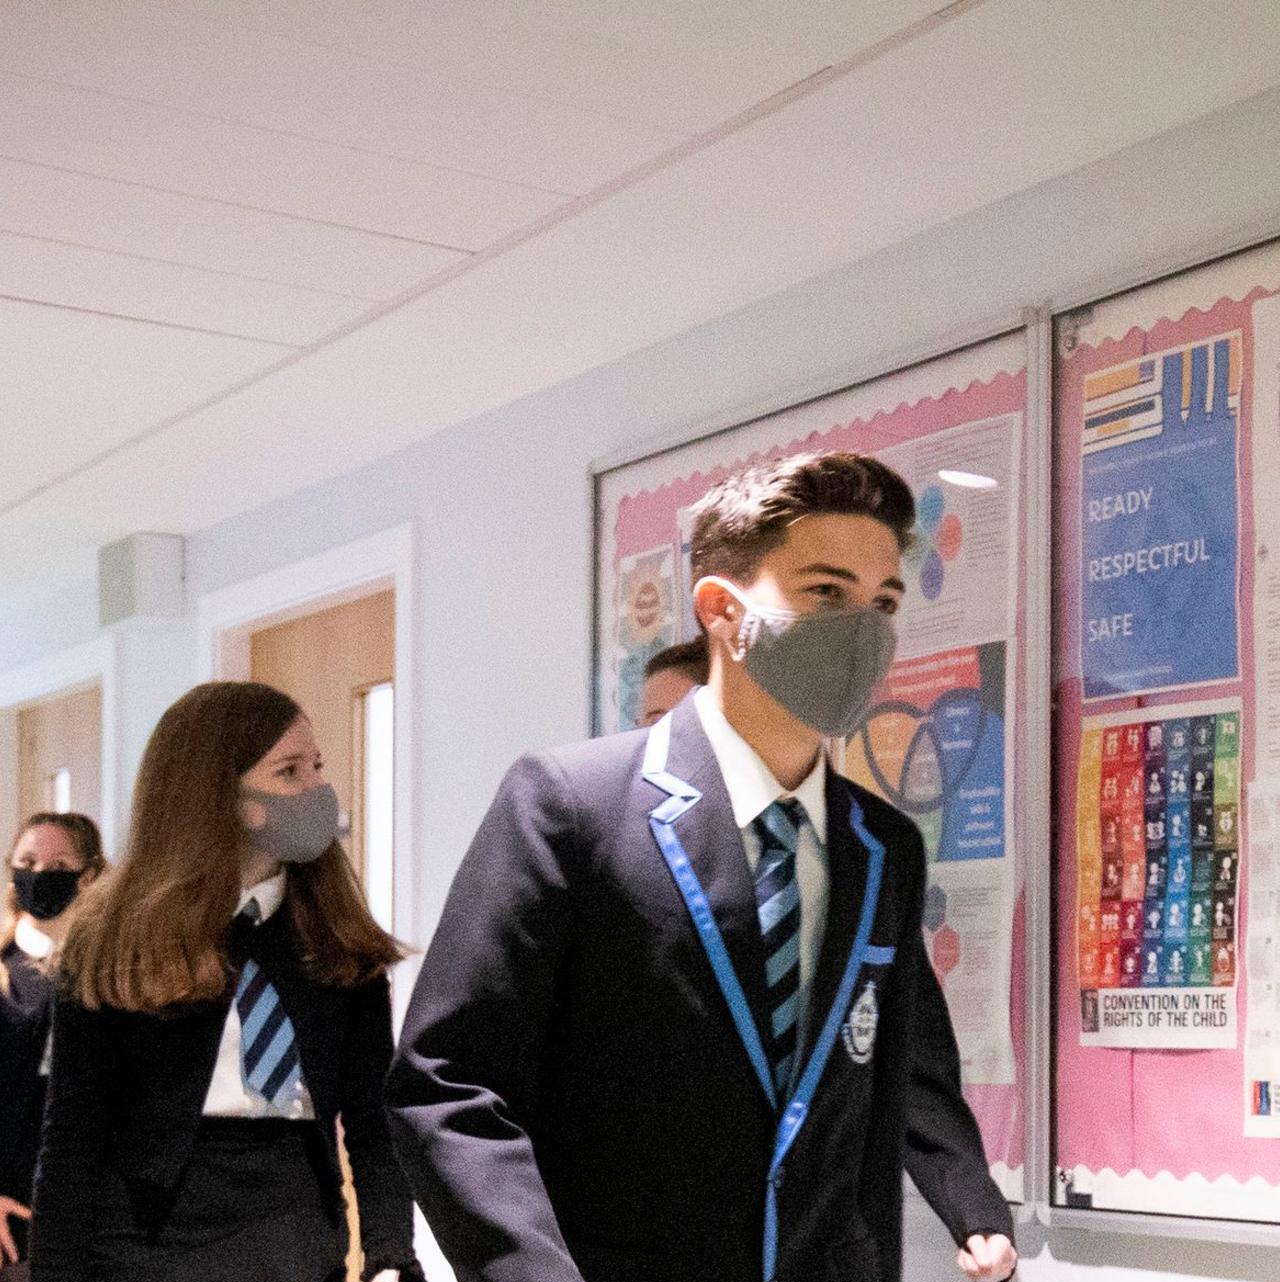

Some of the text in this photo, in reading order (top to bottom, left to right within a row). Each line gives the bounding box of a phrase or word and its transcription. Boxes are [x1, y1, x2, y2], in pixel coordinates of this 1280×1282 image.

[1088, 487, 1153, 522] READY
[1088, 538, 1209, 583] RESPECTFUL
[1088, 613, 1134, 642] SAFE
[1103, 993, 1226, 1011] CONVENTION ON THE
[1103, 1011, 1227, 1028] RIGHTS OF THE CHILD
